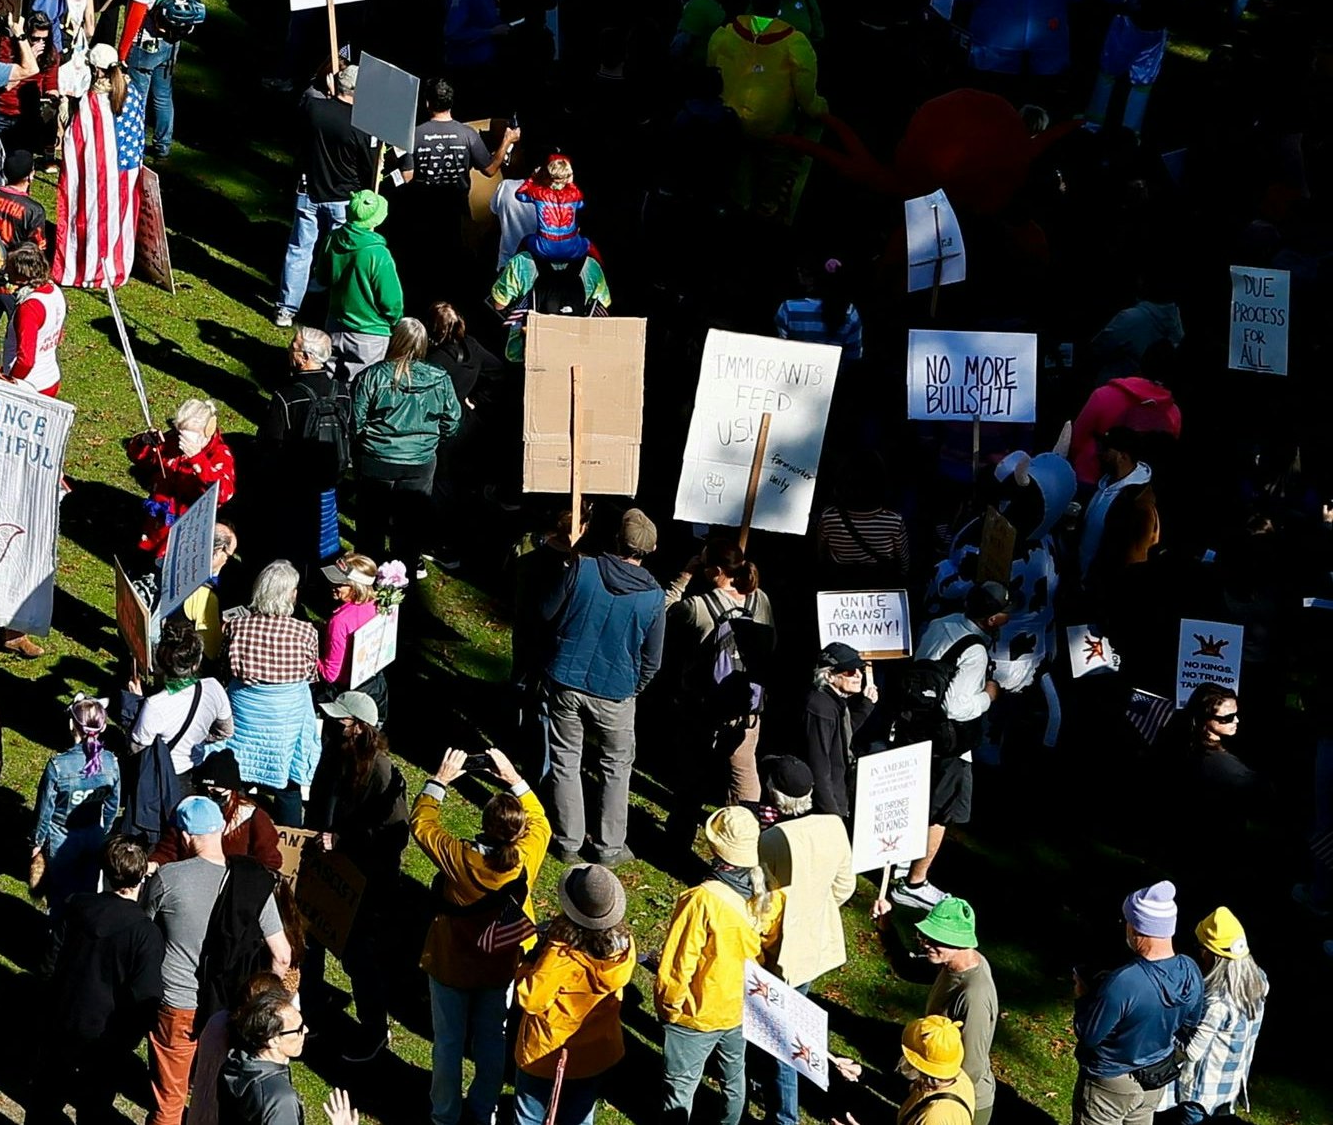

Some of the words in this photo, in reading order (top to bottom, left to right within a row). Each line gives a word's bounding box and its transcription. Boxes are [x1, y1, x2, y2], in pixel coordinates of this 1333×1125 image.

[1244, 274, 1275, 298] DUE
[1233, 301, 1286, 326] PROCESS
[1244, 328, 1266, 345] FOR
[1239, 345, 1266, 367] ALL
[712, 351, 825, 389] IMMIGRANTS
[925, 354, 951, 385] NO
[963, 354, 1018, 387] MORE
[735, 385, 793, 413] FEED
[925, 384, 1018, 417] BULLSHIT
[717, 416, 755, 448] US!
[840, 594, 887, 608] UNITE
[833, 607, 893, 620] AGAINST
[827, 620, 900, 637] TYRANNY!
[1184, 661, 1200, 670] NO
[1181, 671, 1196, 679] NO
[1196, 671, 1234, 684] TRUMP
[874, 803, 883, 813] NO
[884, 797, 909, 812] THRONES
[874, 812, 883, 822] NO
[883, 807, 909, 821] CROWNS
[873, 823, 884, 834] NO
[885, 816, 908, 832] KINGS
